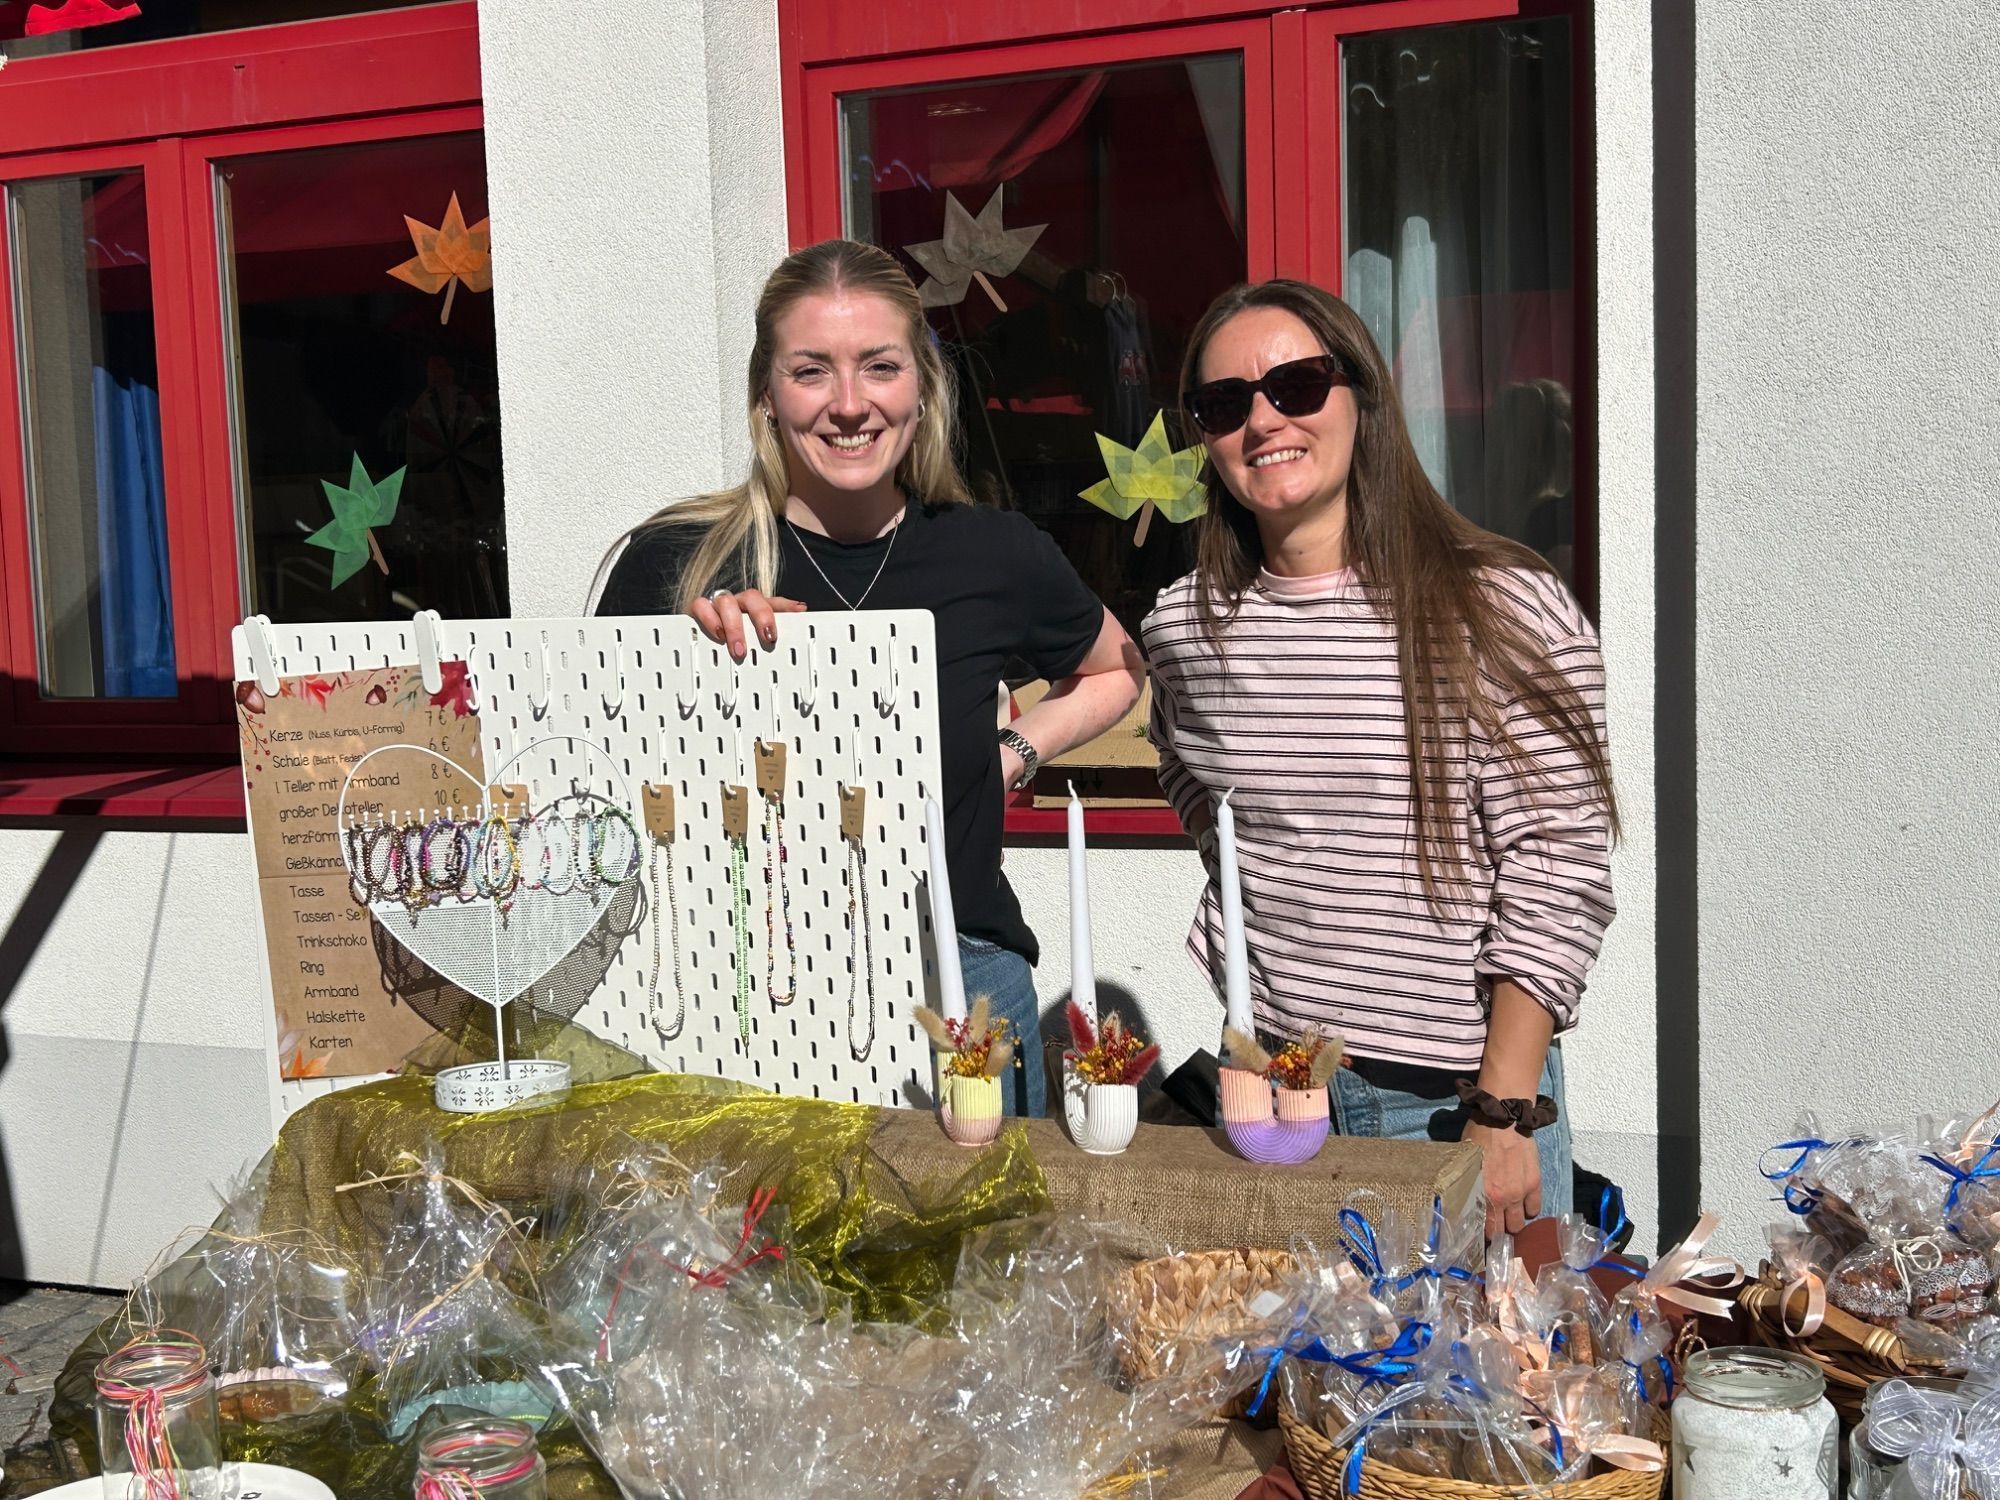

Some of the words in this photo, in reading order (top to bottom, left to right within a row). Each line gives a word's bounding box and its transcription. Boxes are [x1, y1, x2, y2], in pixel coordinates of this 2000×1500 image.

[269, 729, 303, 742] Kerze
[425, 710, 432, 726] 7
[439, 709, 447, 725] €
[273, 753, 309, 768] Schale
[428, 737, 437, 752] 6
[442, 736, 450, 752] €
[283, 780, 316, 793] Teller
[319, 777, 339, 790] mit
[431, 763, 439, 779] 8
[443, 762, 452, 778] €
[279, 805, 319, 823] großer
[434, 789, 447, 805] 10
[452, 788, 461, 804] €
[289, 885, 325, 899] Tasse
[293, 910, 335, 924] Tassen
[346, 908, 366, 921] Se
[297, 935, 367, 949] Trinkschoko
[300, 960, 325, 975] Ring
[304, 985, 359, 998] Armband
[307, 1010, 366, 1023] Halskette
[309, 1036, 353, 1049] Karten
